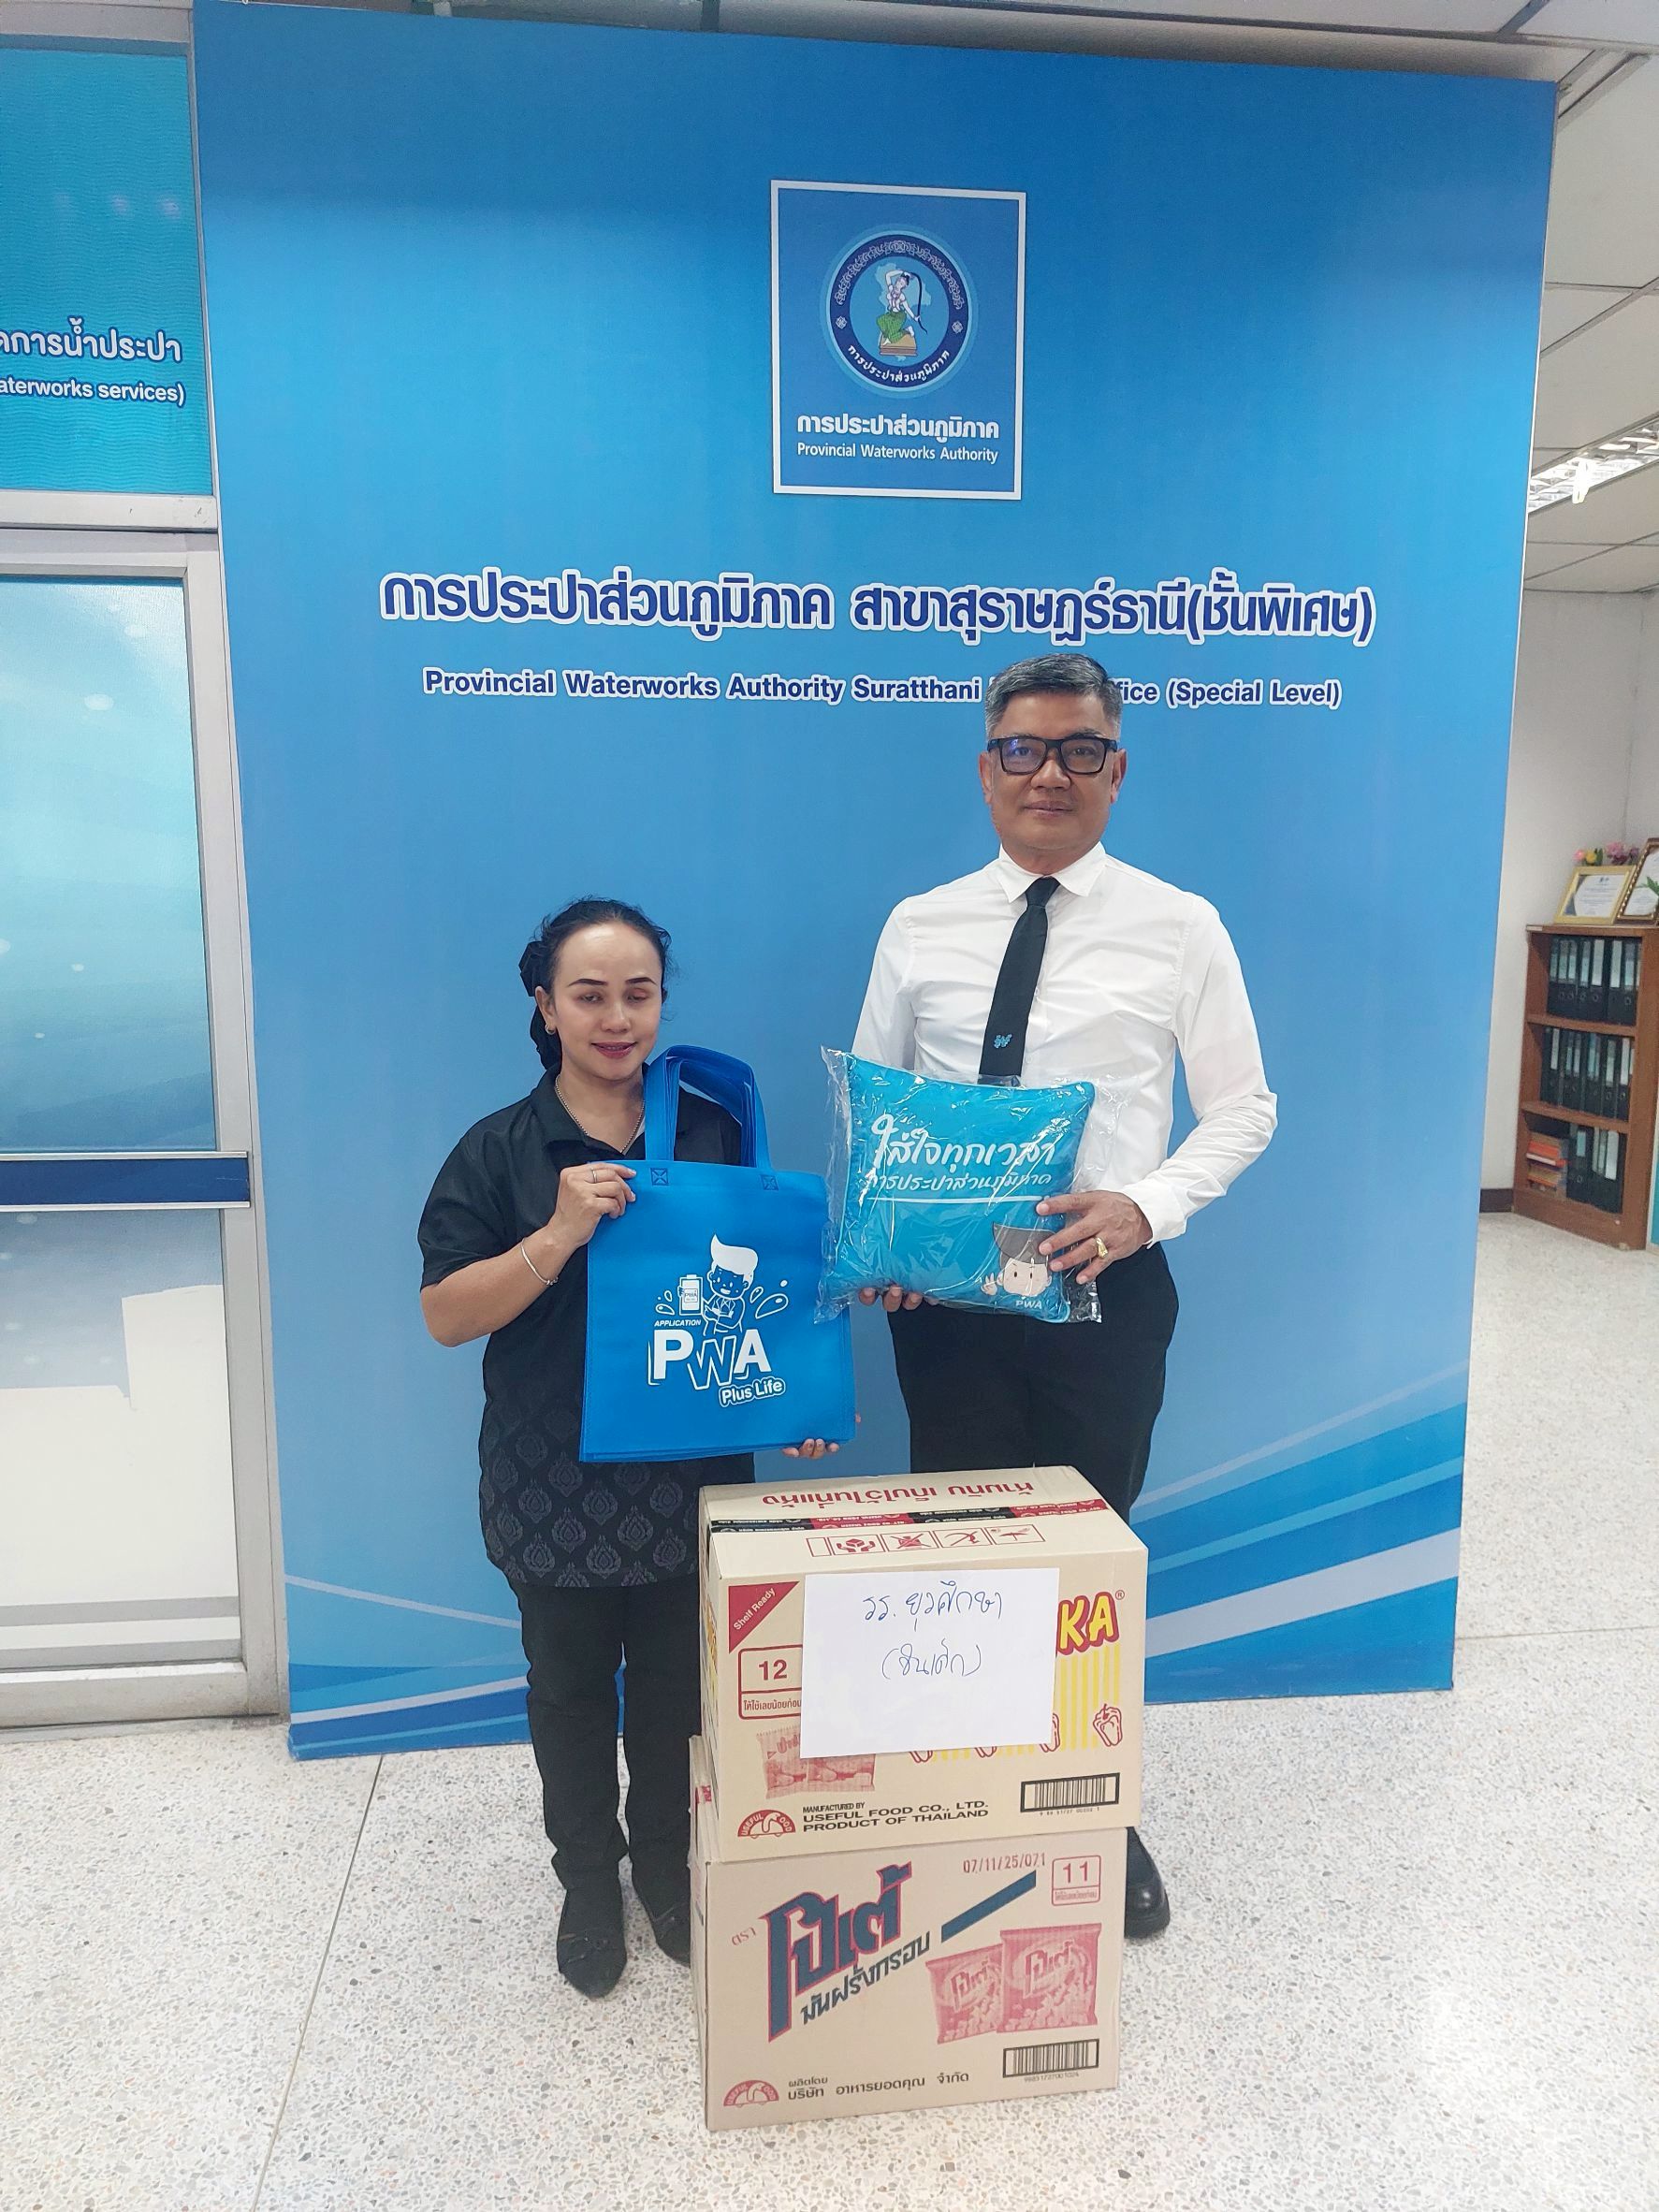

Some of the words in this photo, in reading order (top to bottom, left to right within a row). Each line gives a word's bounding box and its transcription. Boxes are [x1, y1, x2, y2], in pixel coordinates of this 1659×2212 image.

[98, 383, 185, 407] services)
[796, 413, 999, 444] การประปาส่วนภูมิภาค
[797, 442, 856, 458] Provincial
[861, 444, 936, 459] Waterworks
[939, 446, 998, 464] Authority
[381, 568, 834, 639] การประปาส่วนภูมิภาค
[852, 569, 1374, 644] สาขาสุราษฎร์ธานี(ชั้นพิเศษ)
[425, 669, 555, 695] Provincial
[565, 672, 719, 697] Waterworks
[728, 675, 844, 704] Authority
[854, 678, 980, 701] Suratthani
[1168, 679, 1260, 706] (Special
[1273, 680, 1342, 707] Level)
[1015, 1300, 1043, 1310] PWA
[648, 1329, 772, 1390] PWA
[720, 1387, 752, 1404] Plus
[754, 1379, 783, 1396] Life
[762, 1487, 939, 1509] เก็บไว้ในที่แห้ง
[948, 1482, 1034, 1496] ห้ามทับ
[750, 1587, 777, 1613] Ready
[759, 1659, 788, 1681] 12
[803, 1802, 854, 1813] MANUFACTURED
[855, 1801, 866, 1810] BY
[803, 1811, 864, 1823] USEFUL
[868, 1806, 913, 1817] FOOD
[918, 1803, 951, 1813] CO.,
[956, 1799, 989, 1810] LTD.
[741, 1813, 764, 1836] USEFUL
[803, 1818, 881, 1833] PRODUCT
[885, 1816, 907, 1826] OF
[912, 1810, 989, 1823] THAILAND
[963, 1852, 1046, 1874] 07/11/25/071
[1062, 1860, 1088, 1884] 11
[731, 1927, 757, 1946] ตรา
[788, 2075, 828, 2088] ผลิตโดย
[788, 2086, 825, 2102] บริษัท
[836, 2076, 925, 2096] อาหารยอดคุณ
[937, 2071, 969, 2086] จำกัด
